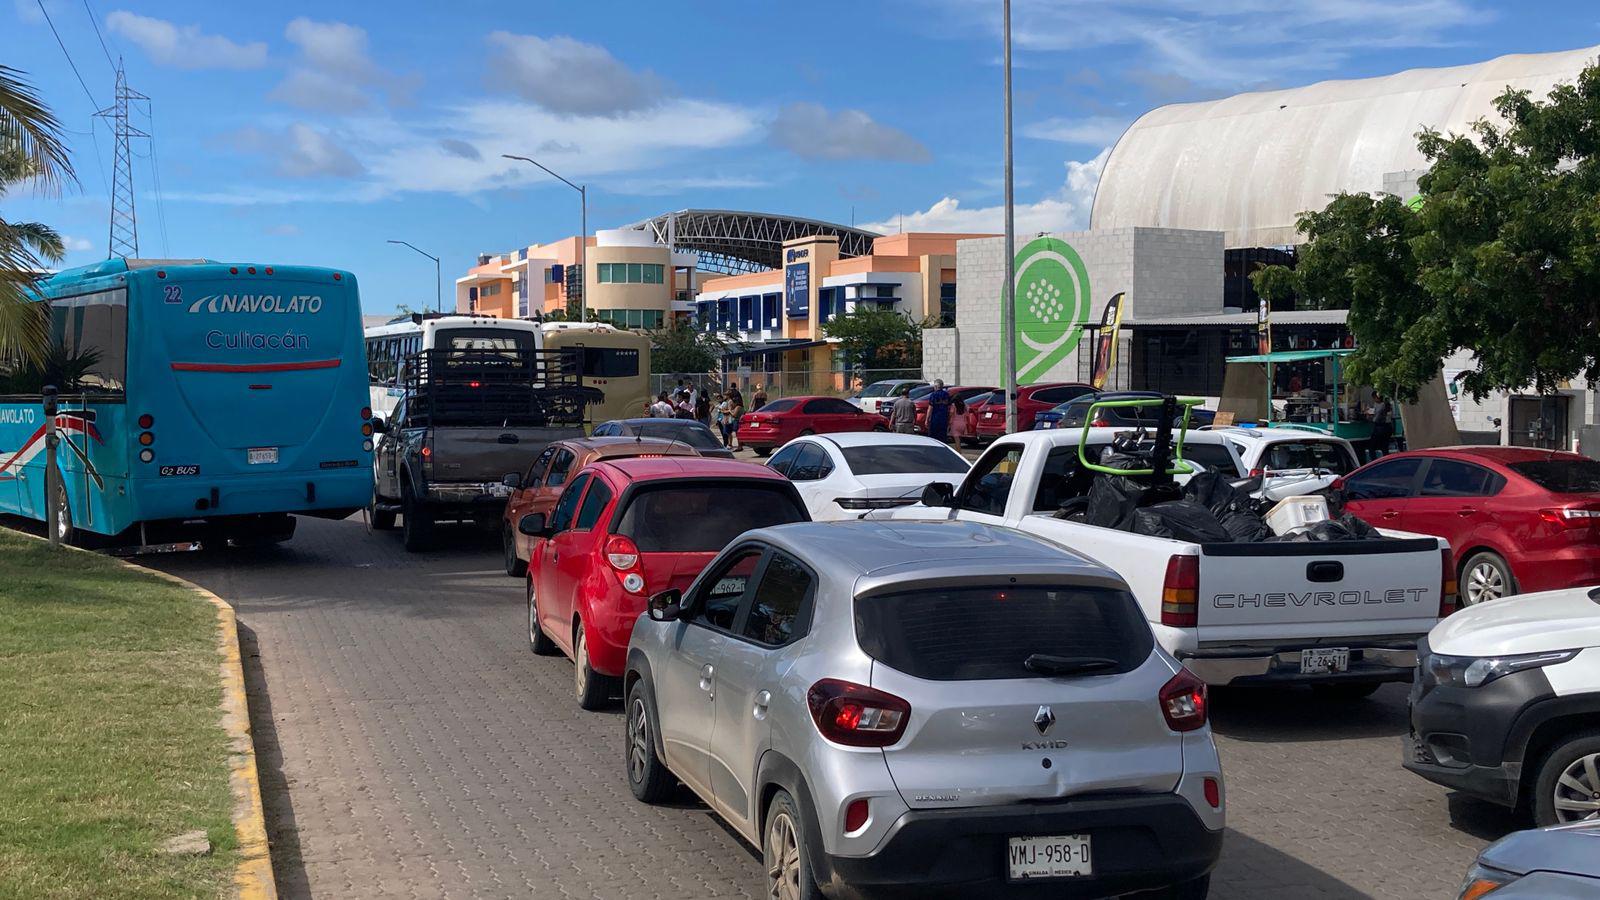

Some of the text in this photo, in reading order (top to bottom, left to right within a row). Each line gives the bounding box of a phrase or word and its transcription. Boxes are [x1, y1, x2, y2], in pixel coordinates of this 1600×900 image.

[163, 285, 183, 304] 22
[220, 294, 323, 313] NAVOLATO
[206, 328, 309, 349] Culiacán
[0, 408, 35, 424] AVOLATO
[161, 466, 197, 476] G2 BUS
[1213, 588, 1428, 609] CHEVROLET
[1021, 740, 1069, 750] KWID
[1010, 843, 1089, 865] VMJ-958-D
